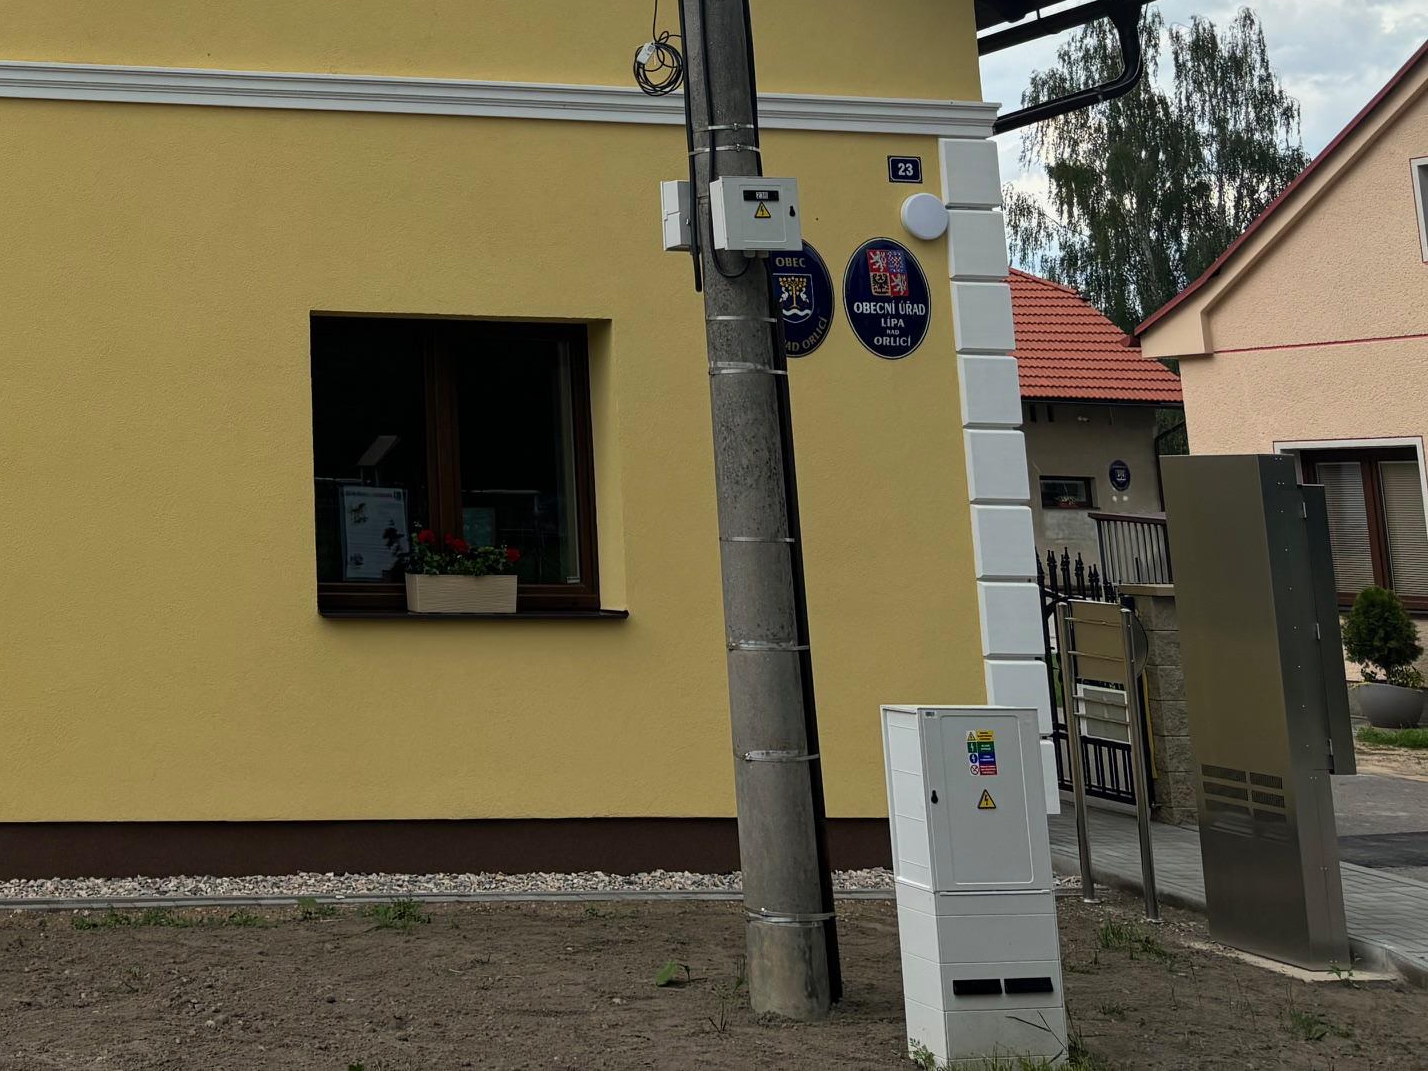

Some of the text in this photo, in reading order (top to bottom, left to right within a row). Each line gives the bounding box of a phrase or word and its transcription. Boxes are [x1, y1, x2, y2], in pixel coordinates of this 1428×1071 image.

[897, 162, 914, 176] 23
[775, 257, 807, 268] OBEC
[853, 300, 926, 316] OBECNÍ ÚŘAD
[881, 316, 905, 327] LÍPA
[783, 315, 828, 352] AD ORLICÍ
[873, 334, 911, 347] ORLICÍ
